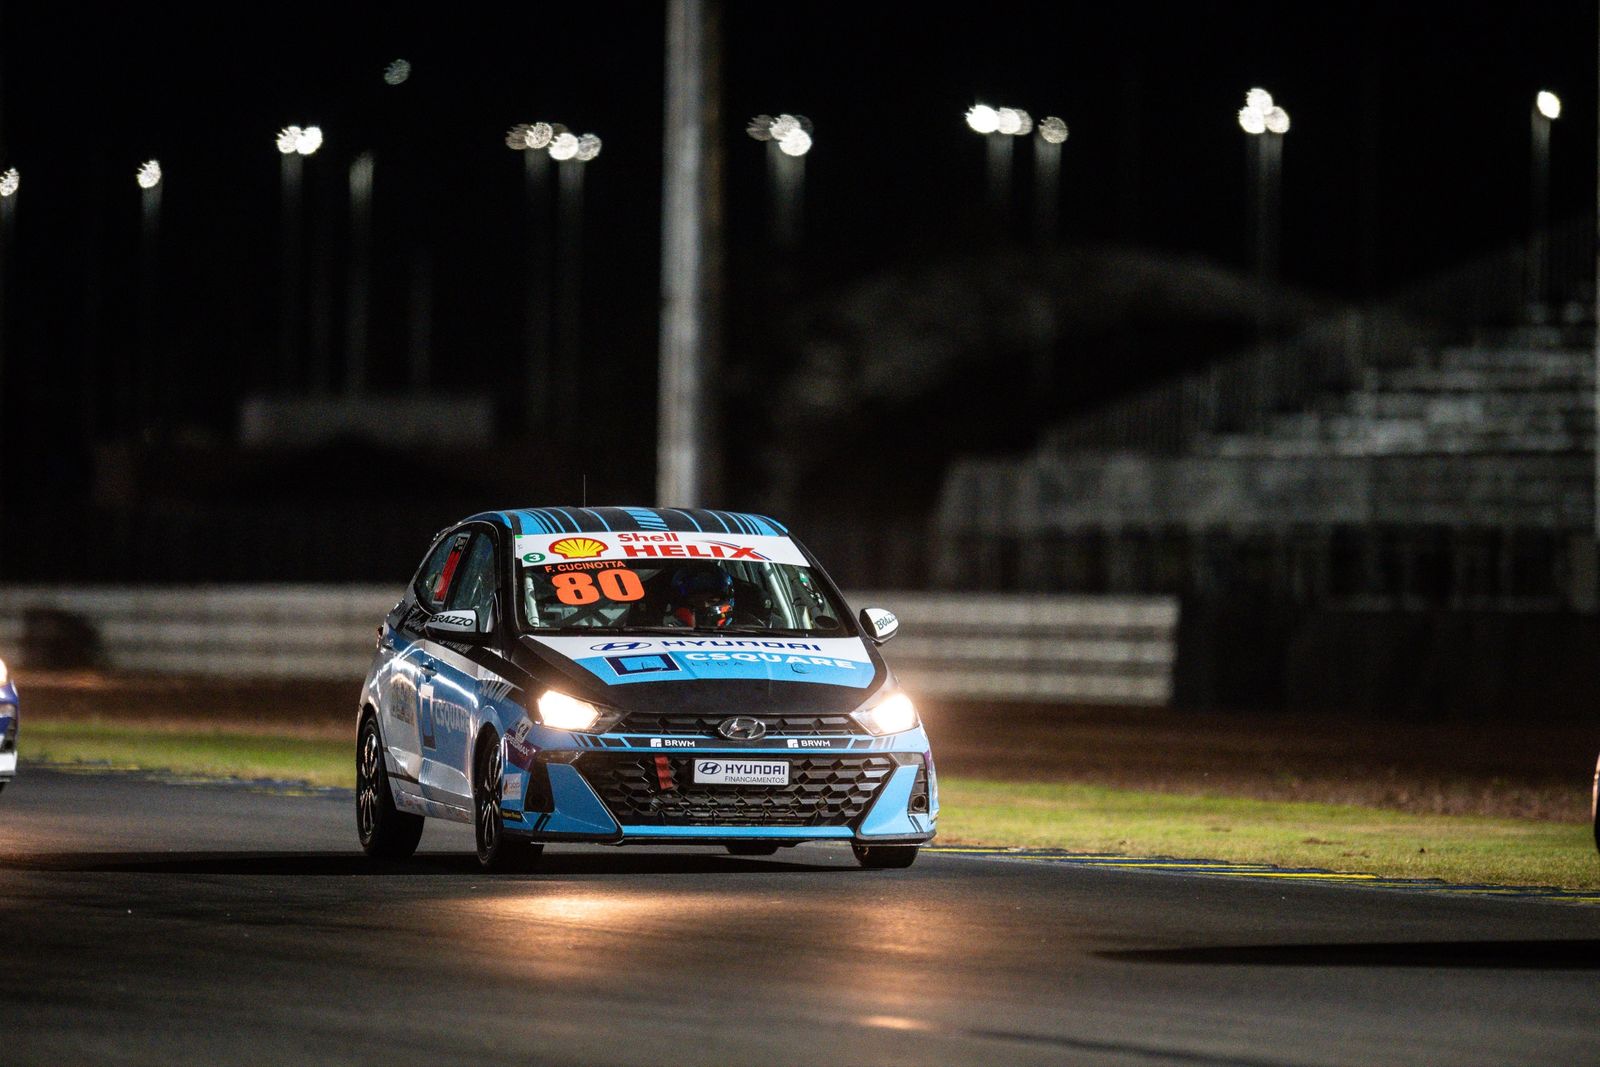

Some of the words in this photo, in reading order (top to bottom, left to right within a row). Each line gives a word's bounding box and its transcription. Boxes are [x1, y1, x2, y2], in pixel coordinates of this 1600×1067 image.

[617, 532, 679, 543] Shell
[622, 544, 767, 560] HELIX
[557, 561, 626, 571] CUCINOTTA
[552, 569, 645, 606] 80
[430, 614, 474, 627] BRAZZO
[661, 640, 822, 651] HYUNDAI
[685, 653, 857, 670] CSQUARE
[664, 739, 695, 747] BRWM
[800, 739, 831, 747] BRWM
[725, 764, 785, 775] HYUNDAI
[724, 776, 785, 784] FINANCIAMENTOS
